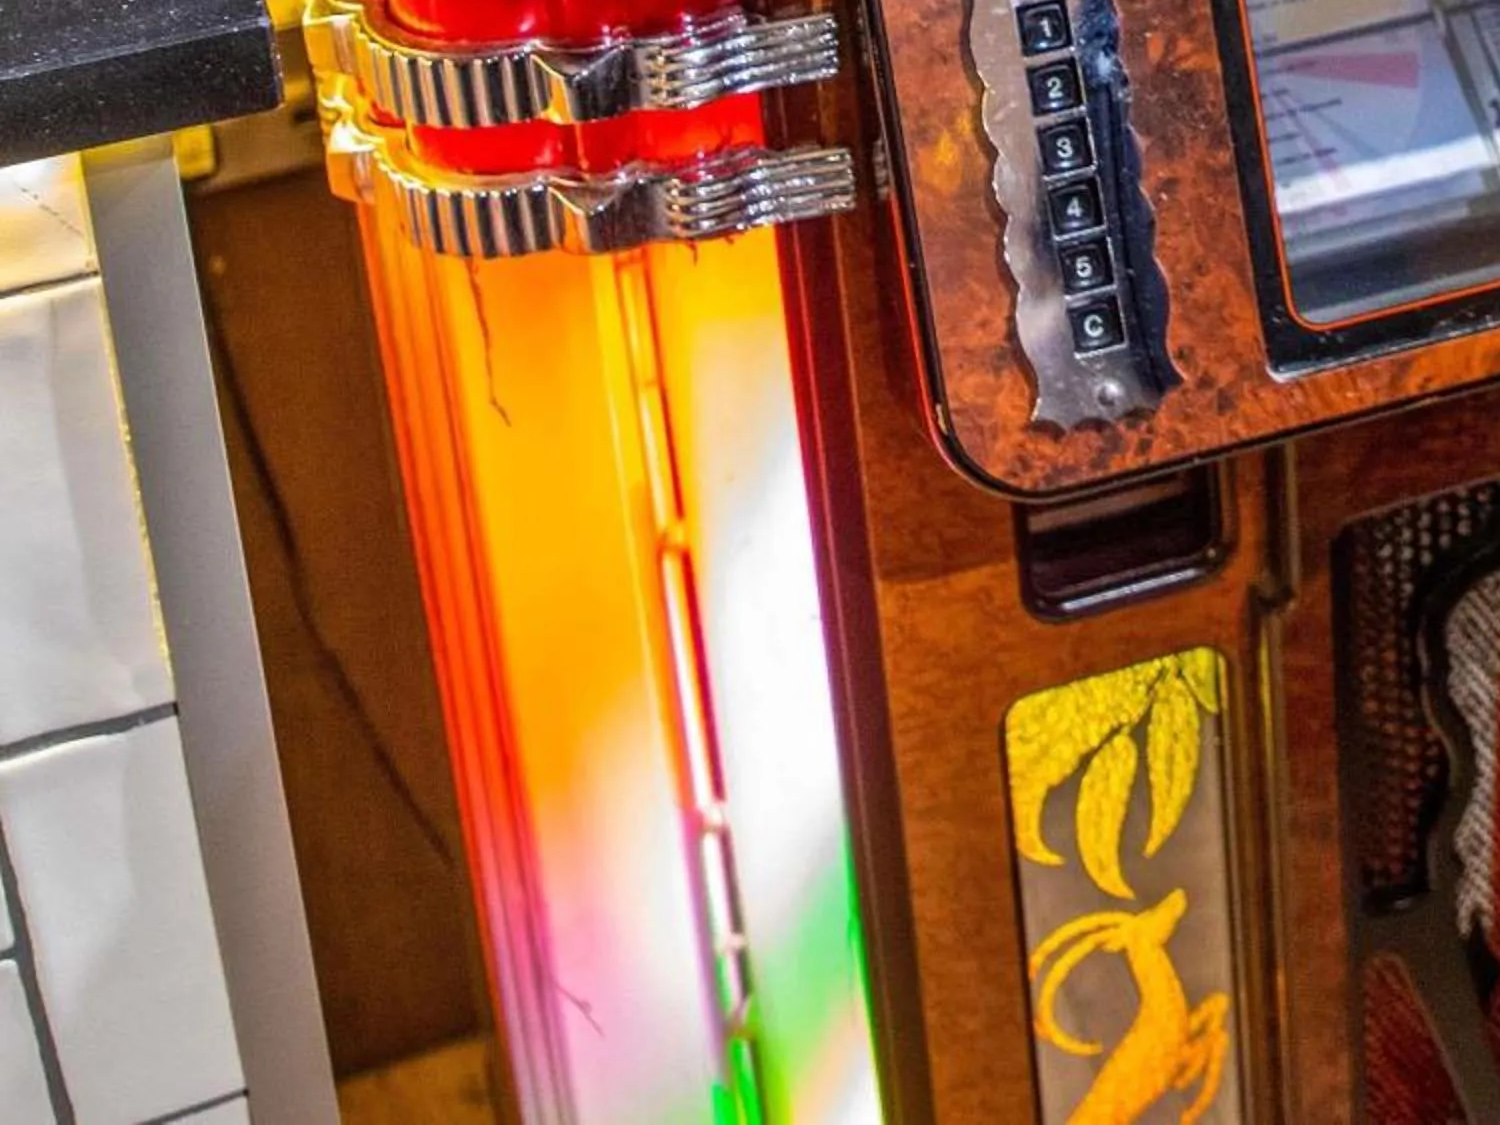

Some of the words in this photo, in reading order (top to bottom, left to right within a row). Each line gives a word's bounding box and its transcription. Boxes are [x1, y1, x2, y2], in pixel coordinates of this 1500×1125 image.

[1040, 19, 1052, 39] 1
[1047, 77, 1063, 98] 2
[1057, 137, 1074, 159] 3
[1066, 197, 1083, 219] 4
[1076, 256, 1092, 277] 5
[1085, 314, 1105, 338] C
